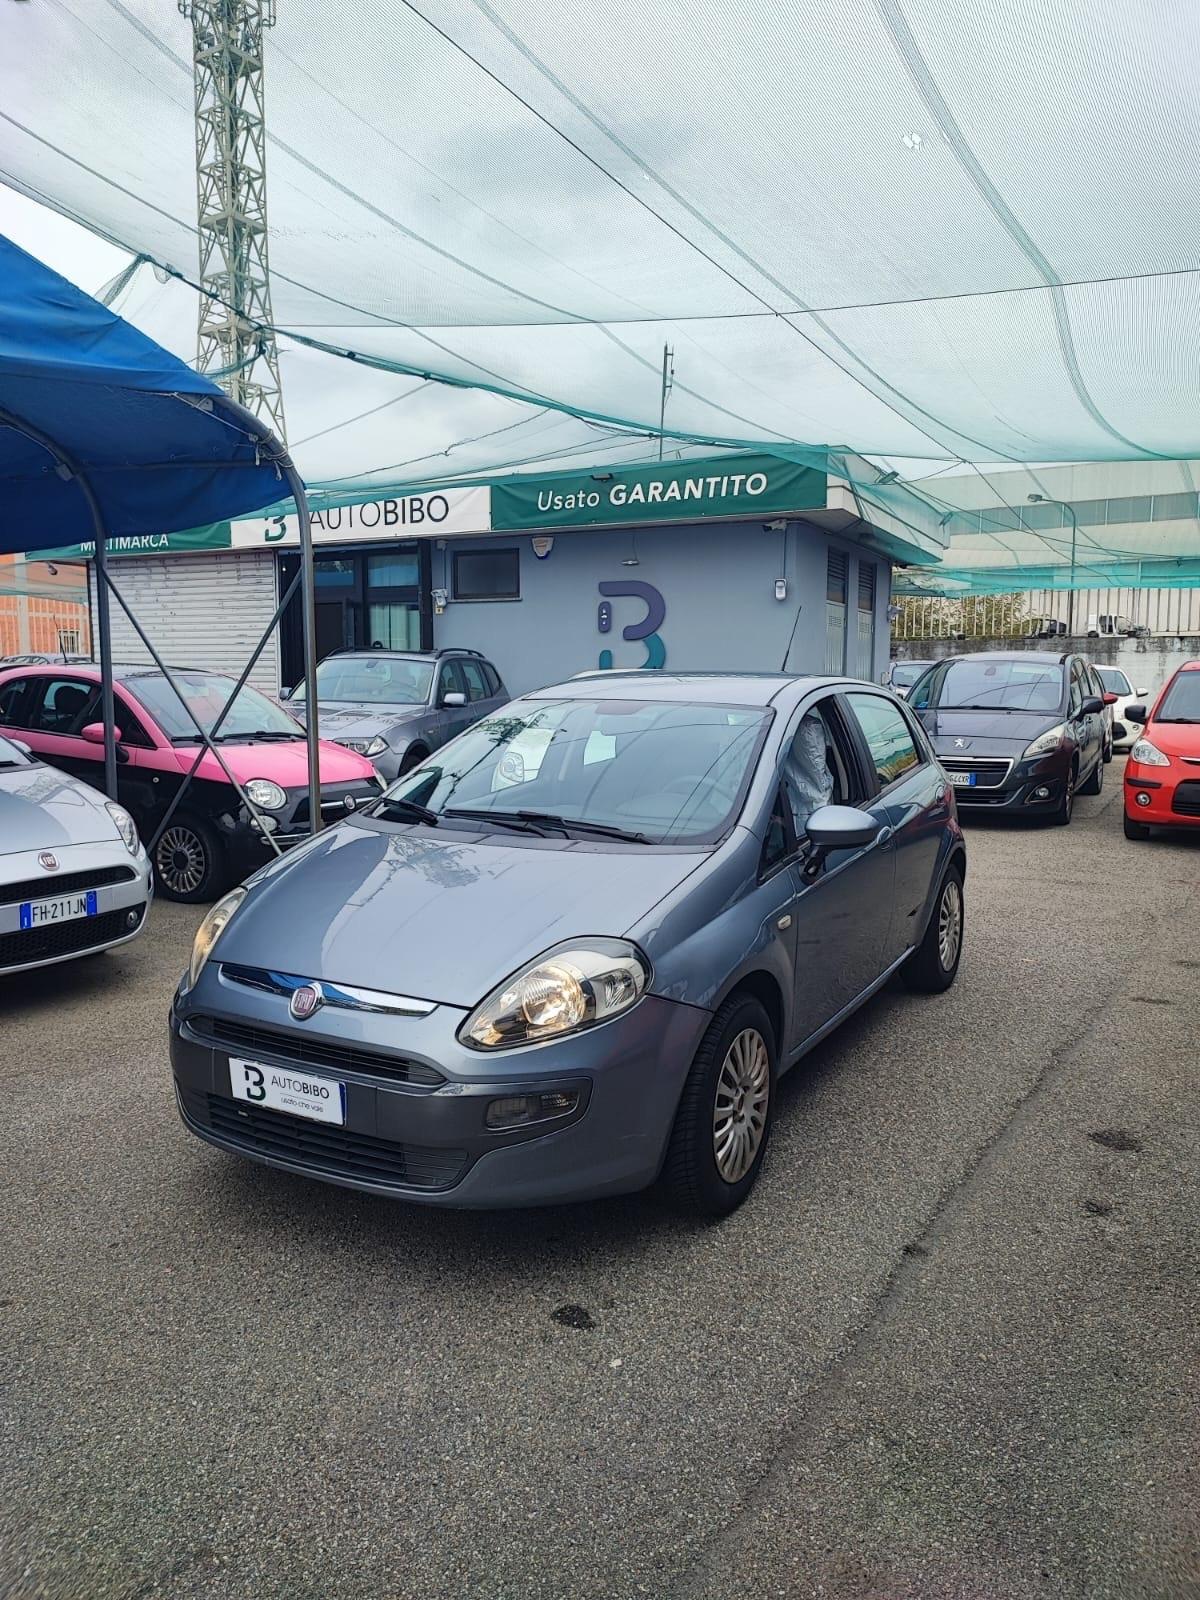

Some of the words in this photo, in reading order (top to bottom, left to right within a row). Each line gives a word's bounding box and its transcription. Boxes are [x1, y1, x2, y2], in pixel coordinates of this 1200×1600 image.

[537, 491, 600, 511] Usato
[609, 473, 768, 506] GARANTITO
[310, 495, 450, 531] AUTOBIBO
[271, 1076, 330, 1099] AUTOBIBO
